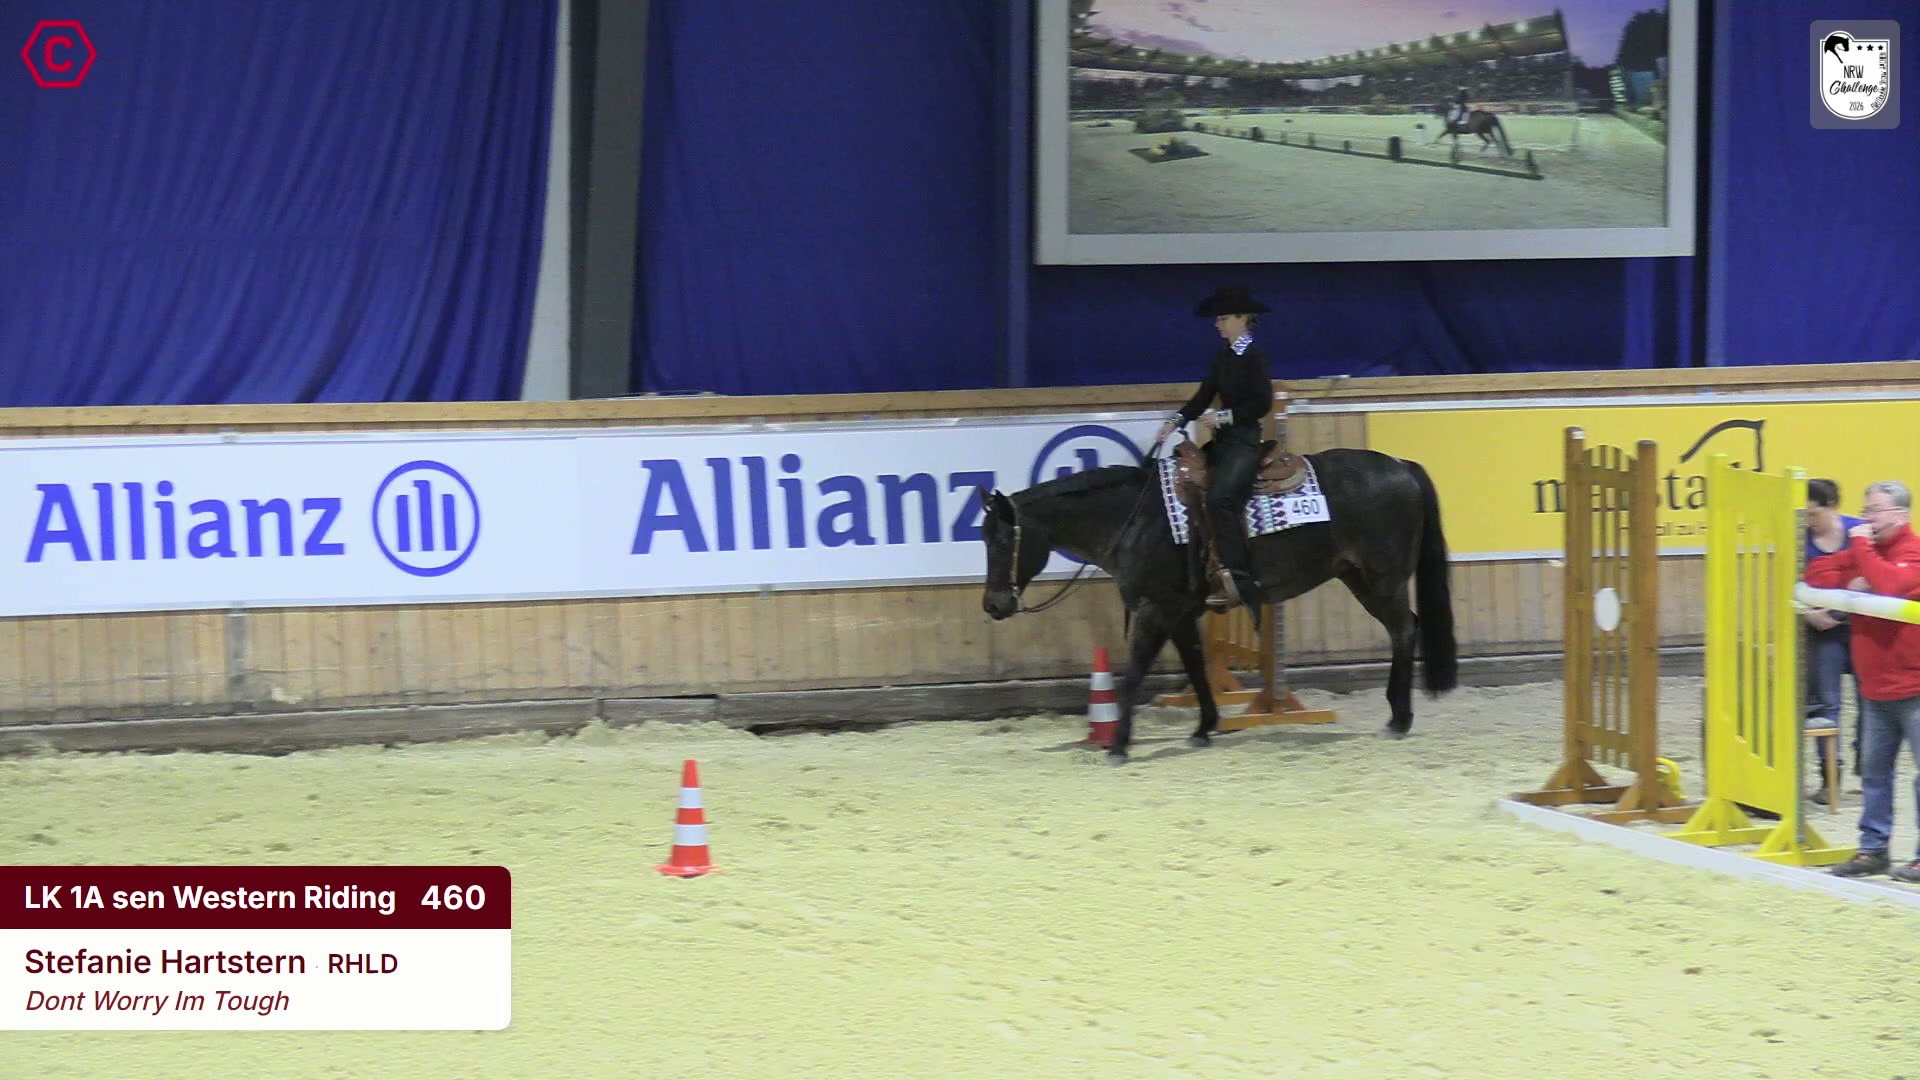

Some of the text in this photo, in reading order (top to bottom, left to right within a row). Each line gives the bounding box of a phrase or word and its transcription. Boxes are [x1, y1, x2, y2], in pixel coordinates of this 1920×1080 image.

[25, 480, 345, 563] Allianz
[631, 453, 997, 555] Allianz
[1292, 498, 1320, 516] 460
